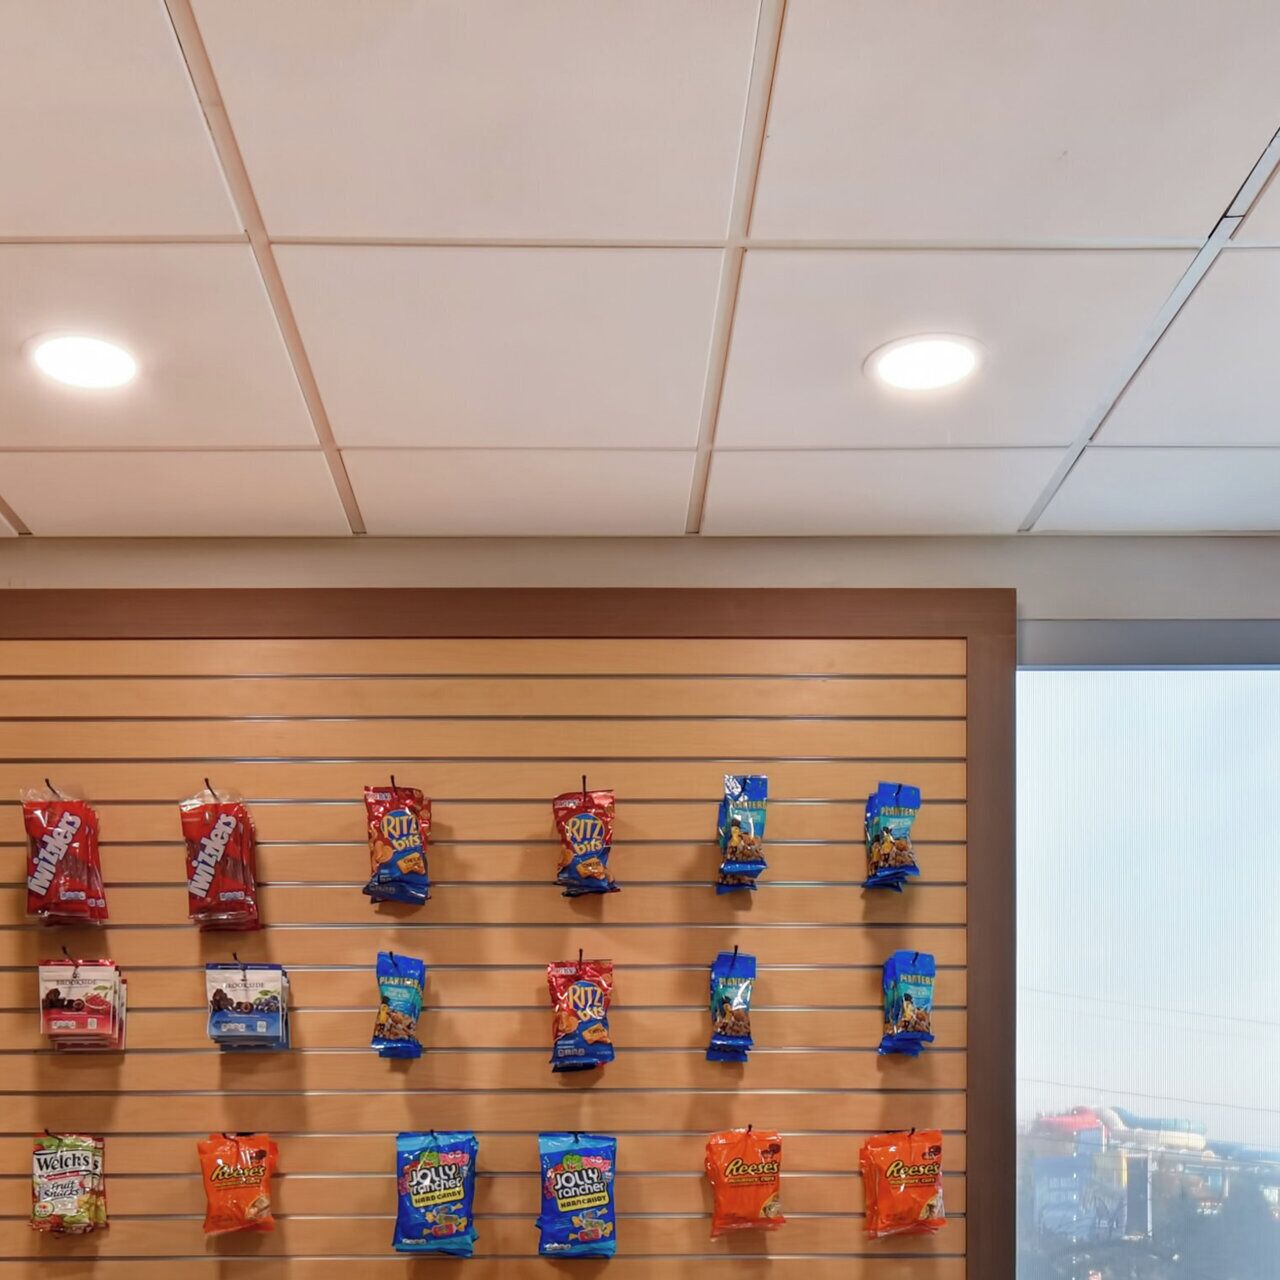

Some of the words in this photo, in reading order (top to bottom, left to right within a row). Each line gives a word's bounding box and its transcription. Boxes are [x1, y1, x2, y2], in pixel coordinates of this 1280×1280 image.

[381, 814, 419, 839] RITZ
[566, 817, 605, 842] RITZ
[392, 833, 421, 851] bits
[574, 839, 602, 856] bits
[568, 984, 604, 1009] RITZ
[578, 1005, 606, 1021] bits
[36, 1152, 91, 1172] Welch's
[726, 1158, 779, 1176] Reese's
[886, 1161, 940, 1178] Reese's
[410, 1163, 459, 1187] JOLLY
[554, 1168, 601, 1191] JOLLY
[41, 1188, 80, 1200] Snacks
[51, 1180, 76, 1192] Fruit
[411, 1176, 463, 1196] rancher
[557, 1182, 606, 1199] rancher
